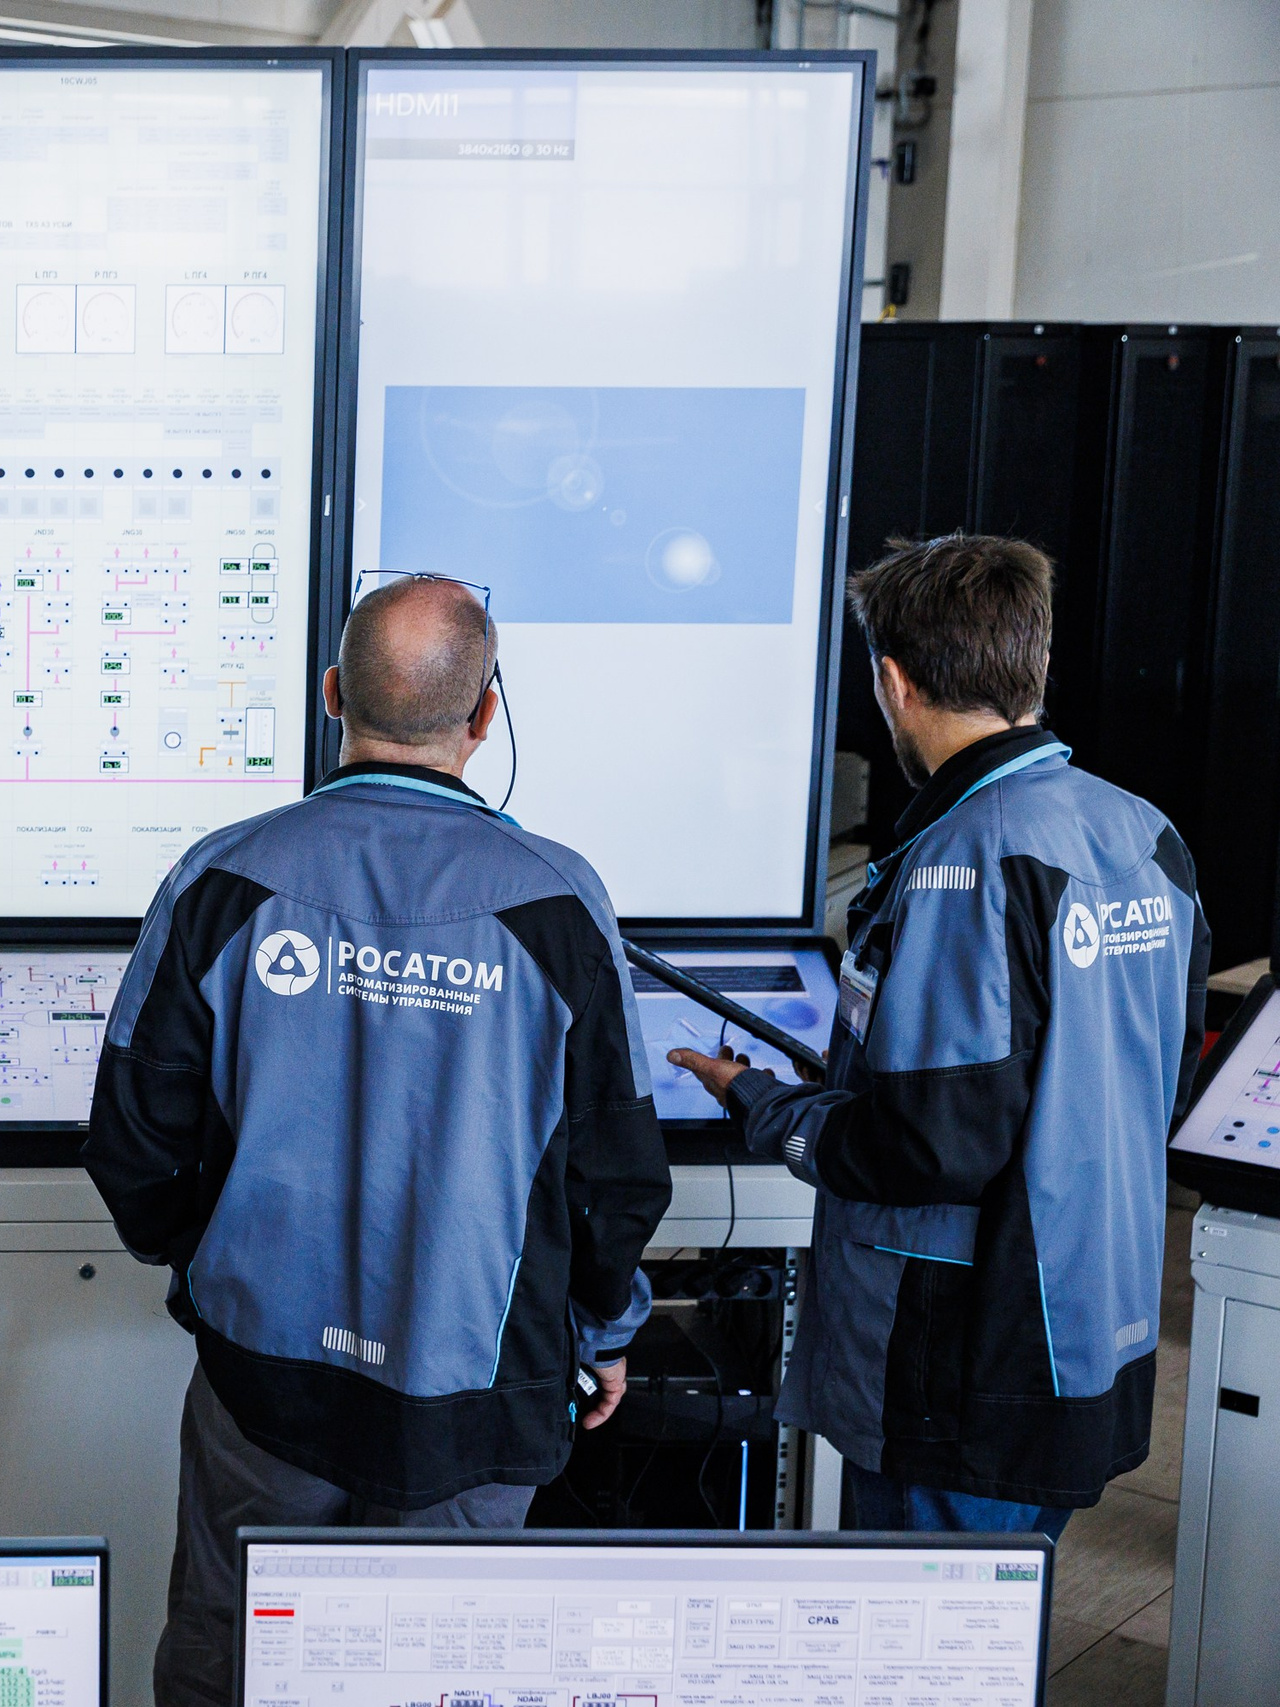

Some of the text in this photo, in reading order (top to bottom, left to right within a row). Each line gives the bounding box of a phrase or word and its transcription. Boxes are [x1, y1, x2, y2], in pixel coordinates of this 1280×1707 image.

[60, 77, 97, 85] 10CWJ05
[374, 92, 459, 118] HDMI1
[458, 144, 569, 157] 3840x2160 @ 30 Hz
[338, 941, 504, 992] РОСАТОМ
[338, 972, 480, 1004] АВТОМАТИЗИРОВАННЫЕ
[338, 985, 473, 1016] СИСТЕМЫ УПРАВЛЕНИЯ
[808, 1617, 839, 1625] СРАБ
